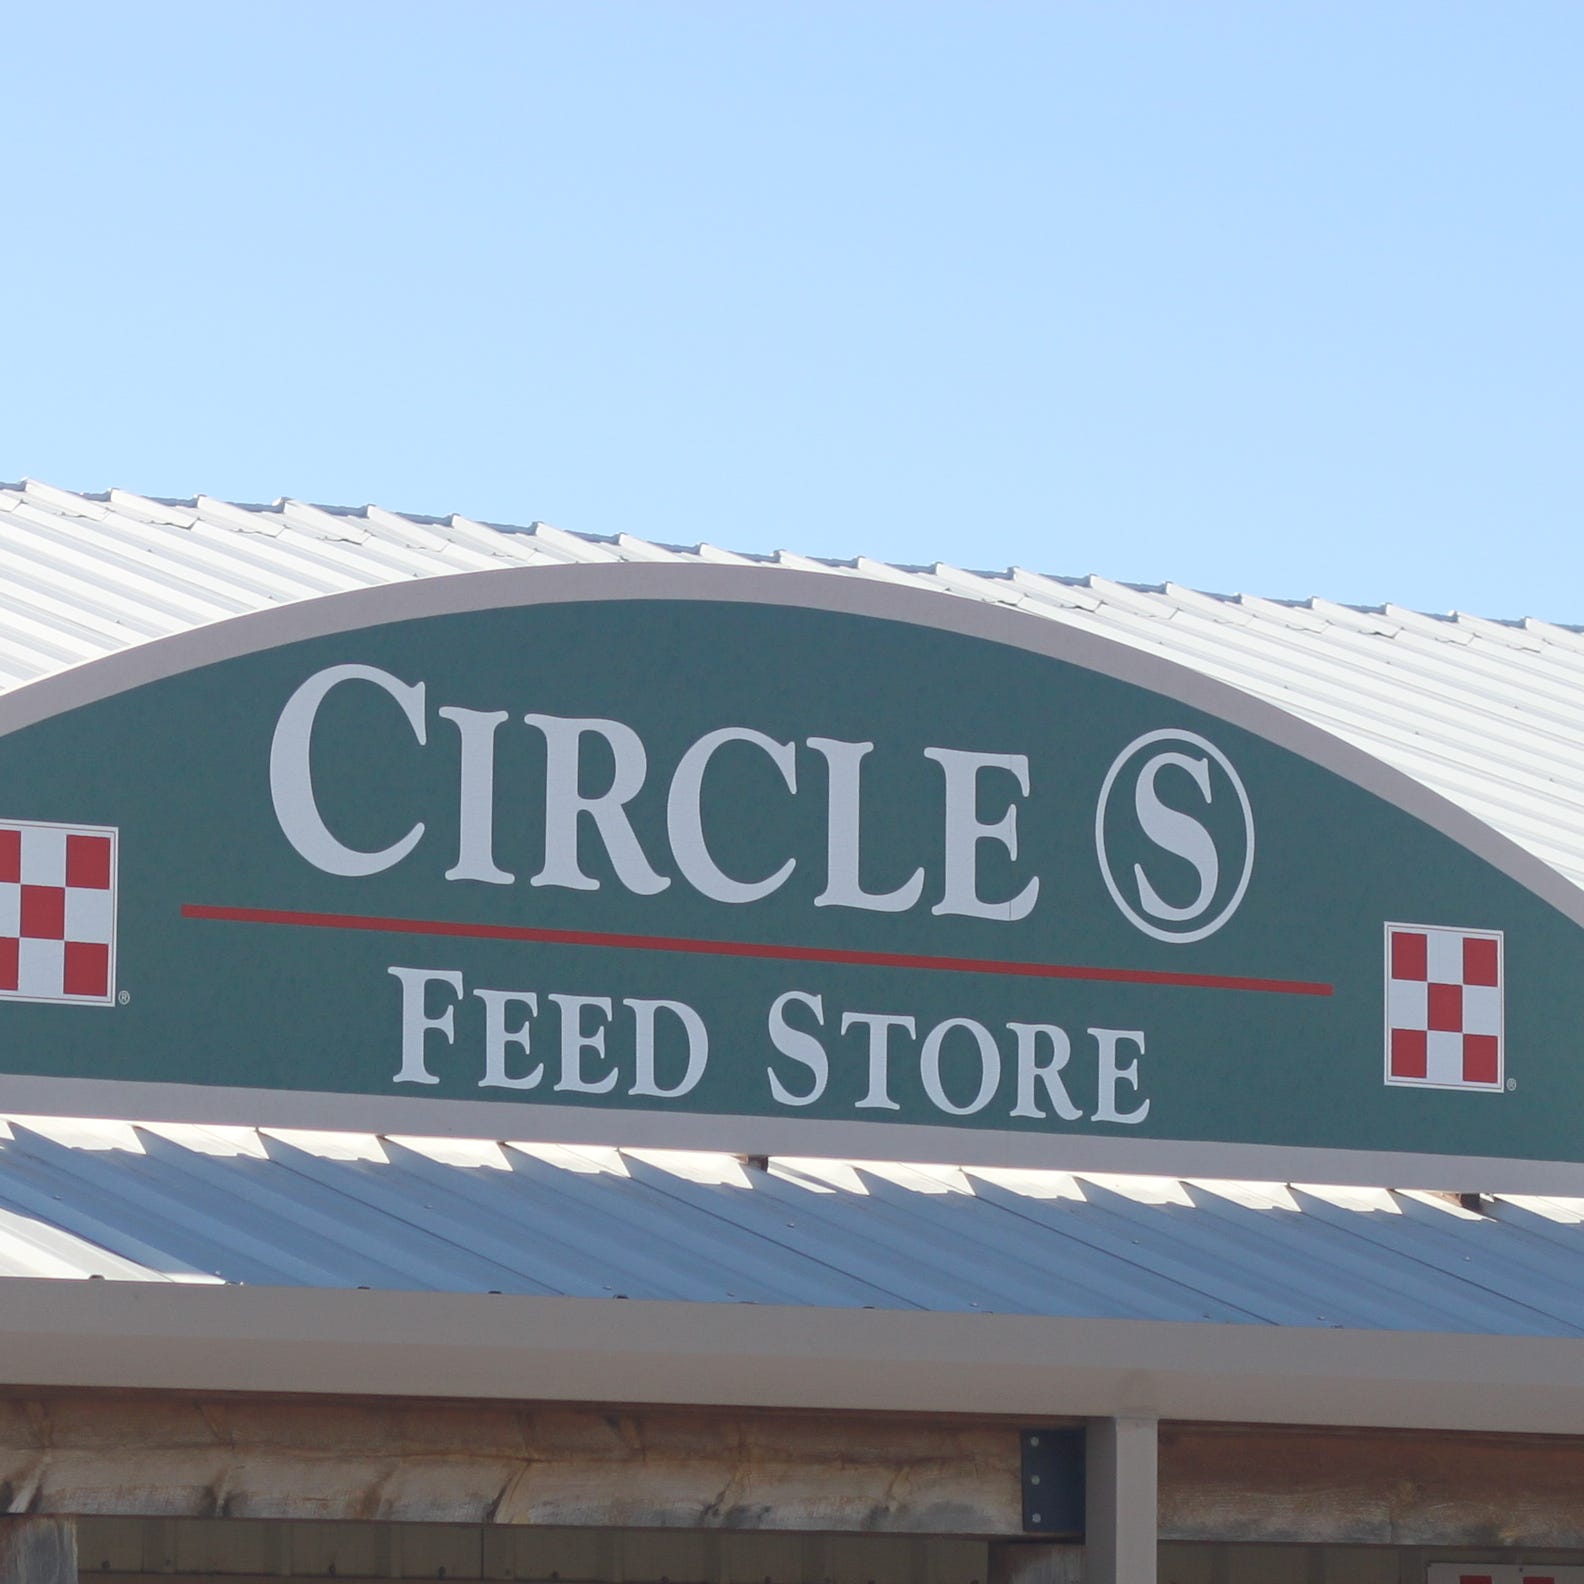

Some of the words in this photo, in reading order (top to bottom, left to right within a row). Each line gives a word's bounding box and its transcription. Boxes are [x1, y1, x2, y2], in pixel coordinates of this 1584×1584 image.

[269, 663, 1039, 922] CIRCLE
[387, 965, 709, 1098] FEED
[766, 990, 1151, 1125] STORE
